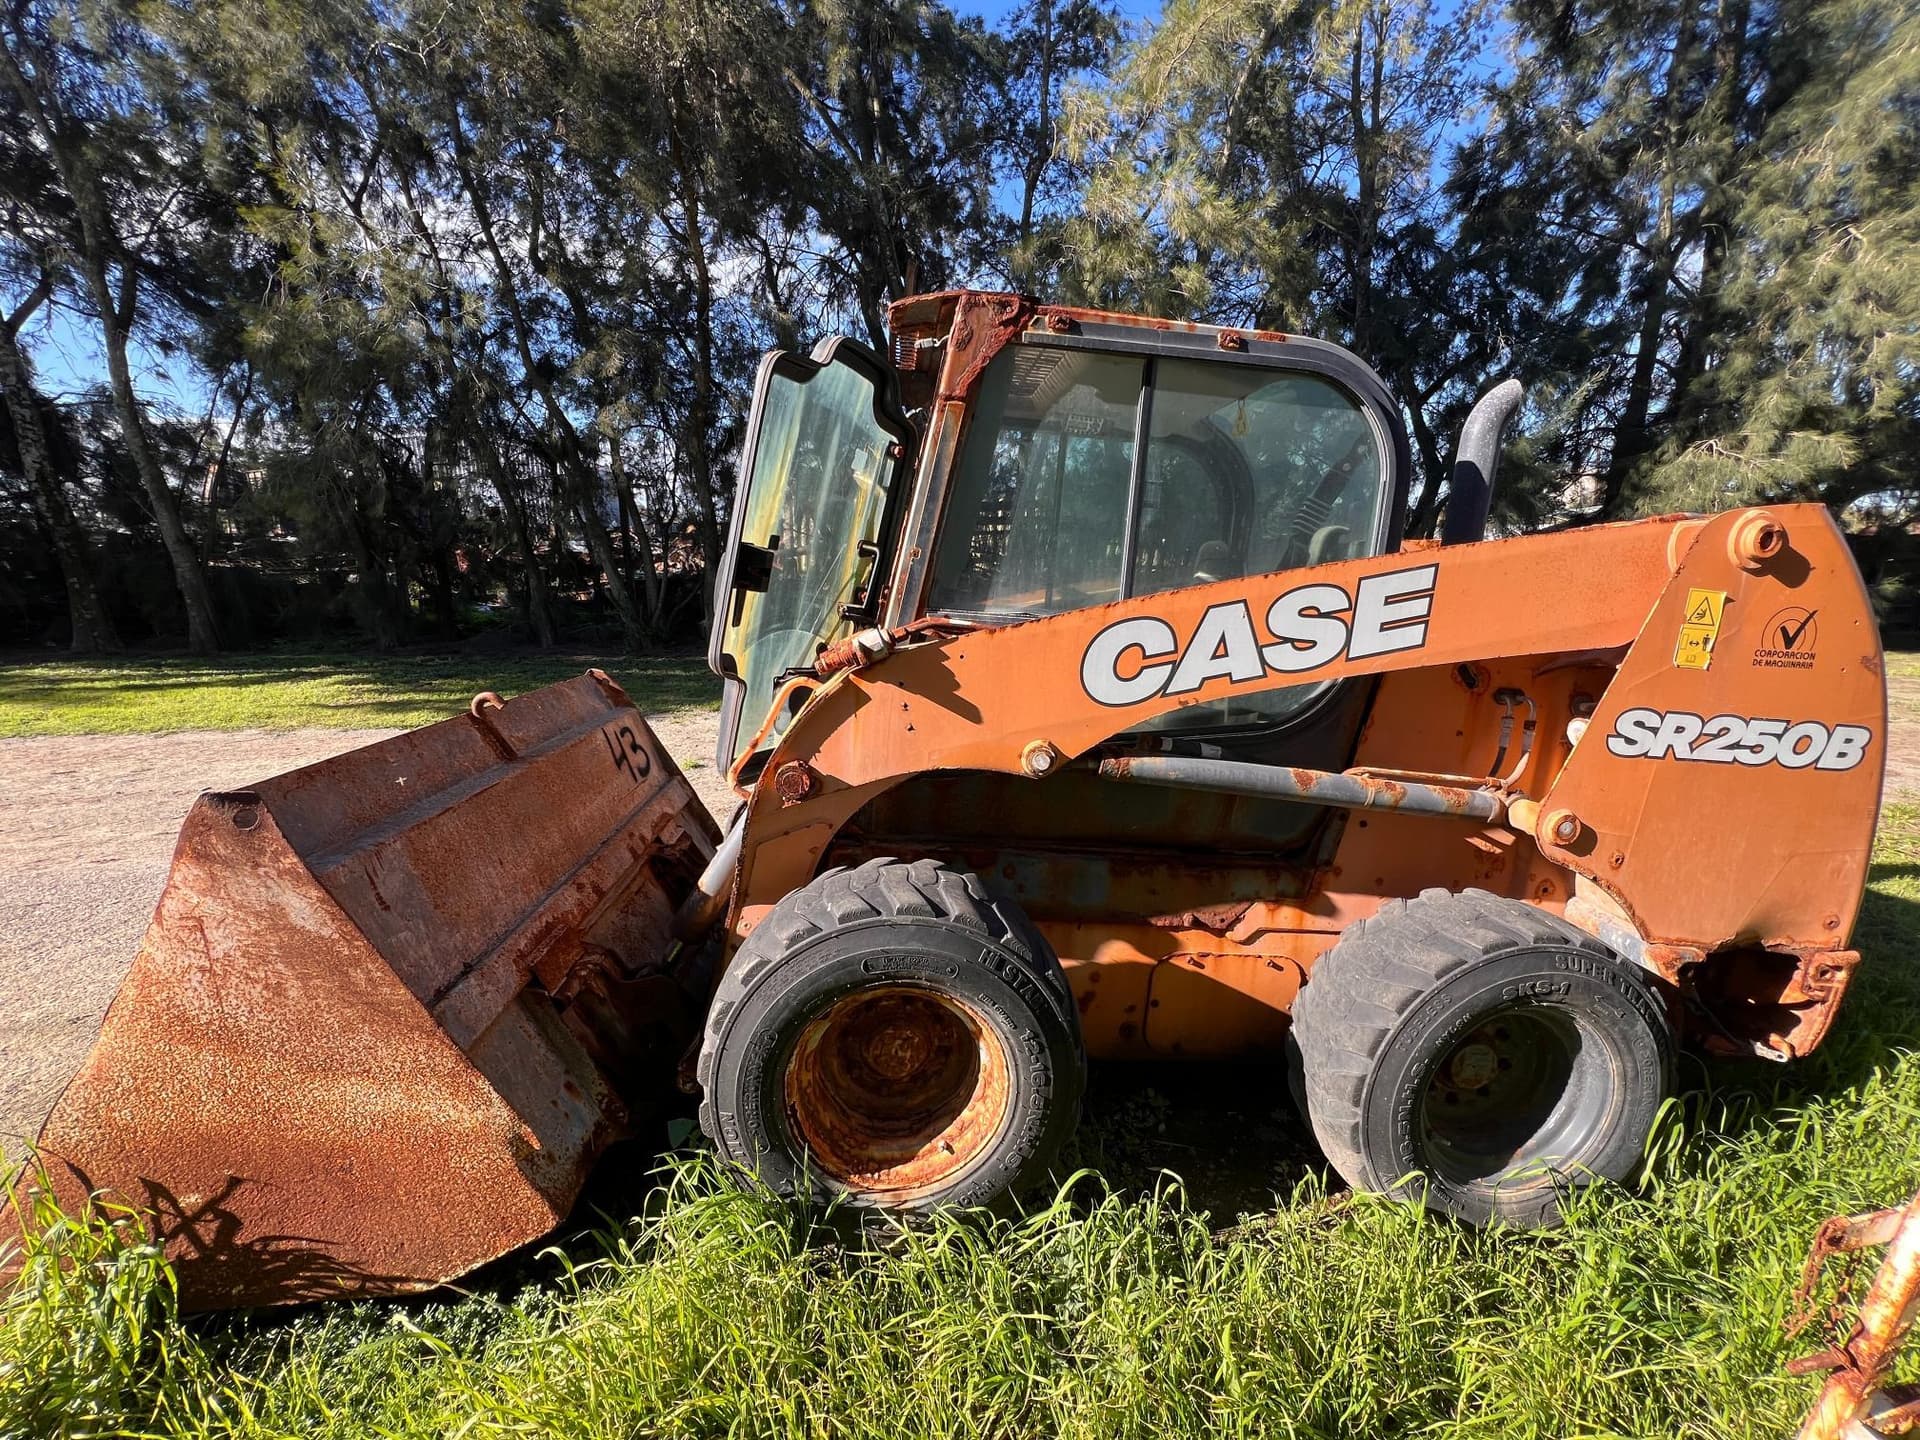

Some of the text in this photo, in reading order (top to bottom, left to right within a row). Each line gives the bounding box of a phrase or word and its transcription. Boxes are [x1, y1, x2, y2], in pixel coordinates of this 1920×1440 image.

[1080, 563, 1440, 707] CASE
[1754, 649, 1816, 661] CORPORACION
[1752, 658, 1814, 670] DE MAQUINARIA
[601, 726, 651, 783] 43
[1606, 707, 1872, 771] SR250B
[1501, 979, 1570, 1001] SKS-1
[1555, 954, 1616, 986] SUPER
[1396, 992, 1451, 1051] TUBELESS
